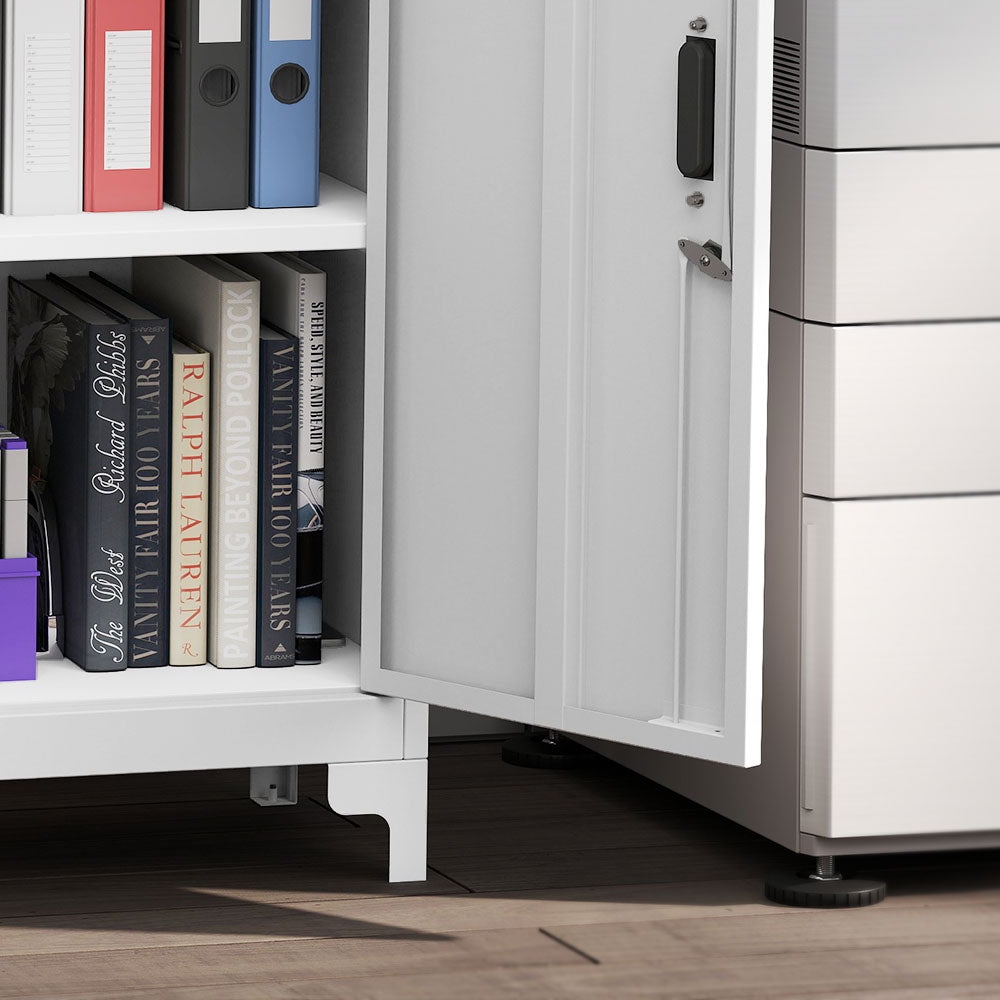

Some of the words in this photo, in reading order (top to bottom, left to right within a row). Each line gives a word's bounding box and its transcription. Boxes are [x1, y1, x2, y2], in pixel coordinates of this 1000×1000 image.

[224, 288, 254, 407] POLLOCK
[309, 301, 325, 342] SPEED,
[92, 330, 127, 405] Phibbs
[135, 358, 161, 438] YEARS
[271, 344, 296, 438] VANITY
[309, 344, 324, 382] STYLE,
[310, 384, 324, 407] AND
[91, 410, 126, 504] Richard
[181, 361, 205, 479] RALPH
[309, 411, 323, 454] BEAUTY
[224, 415, 252, 524] BEYOND
[271, 443, 293, 499] FAIR
[134, 498, 160, 558] FAIR
[178, 491, 203, 630] LAUREN
[90, 546, 124, 606] West
[132, 566, 159, 662] VANITY
[223, 532, 251, 659] PAINTING
[269, 555, 292, 632] YEARS
[90, 622, 124, 663] The
